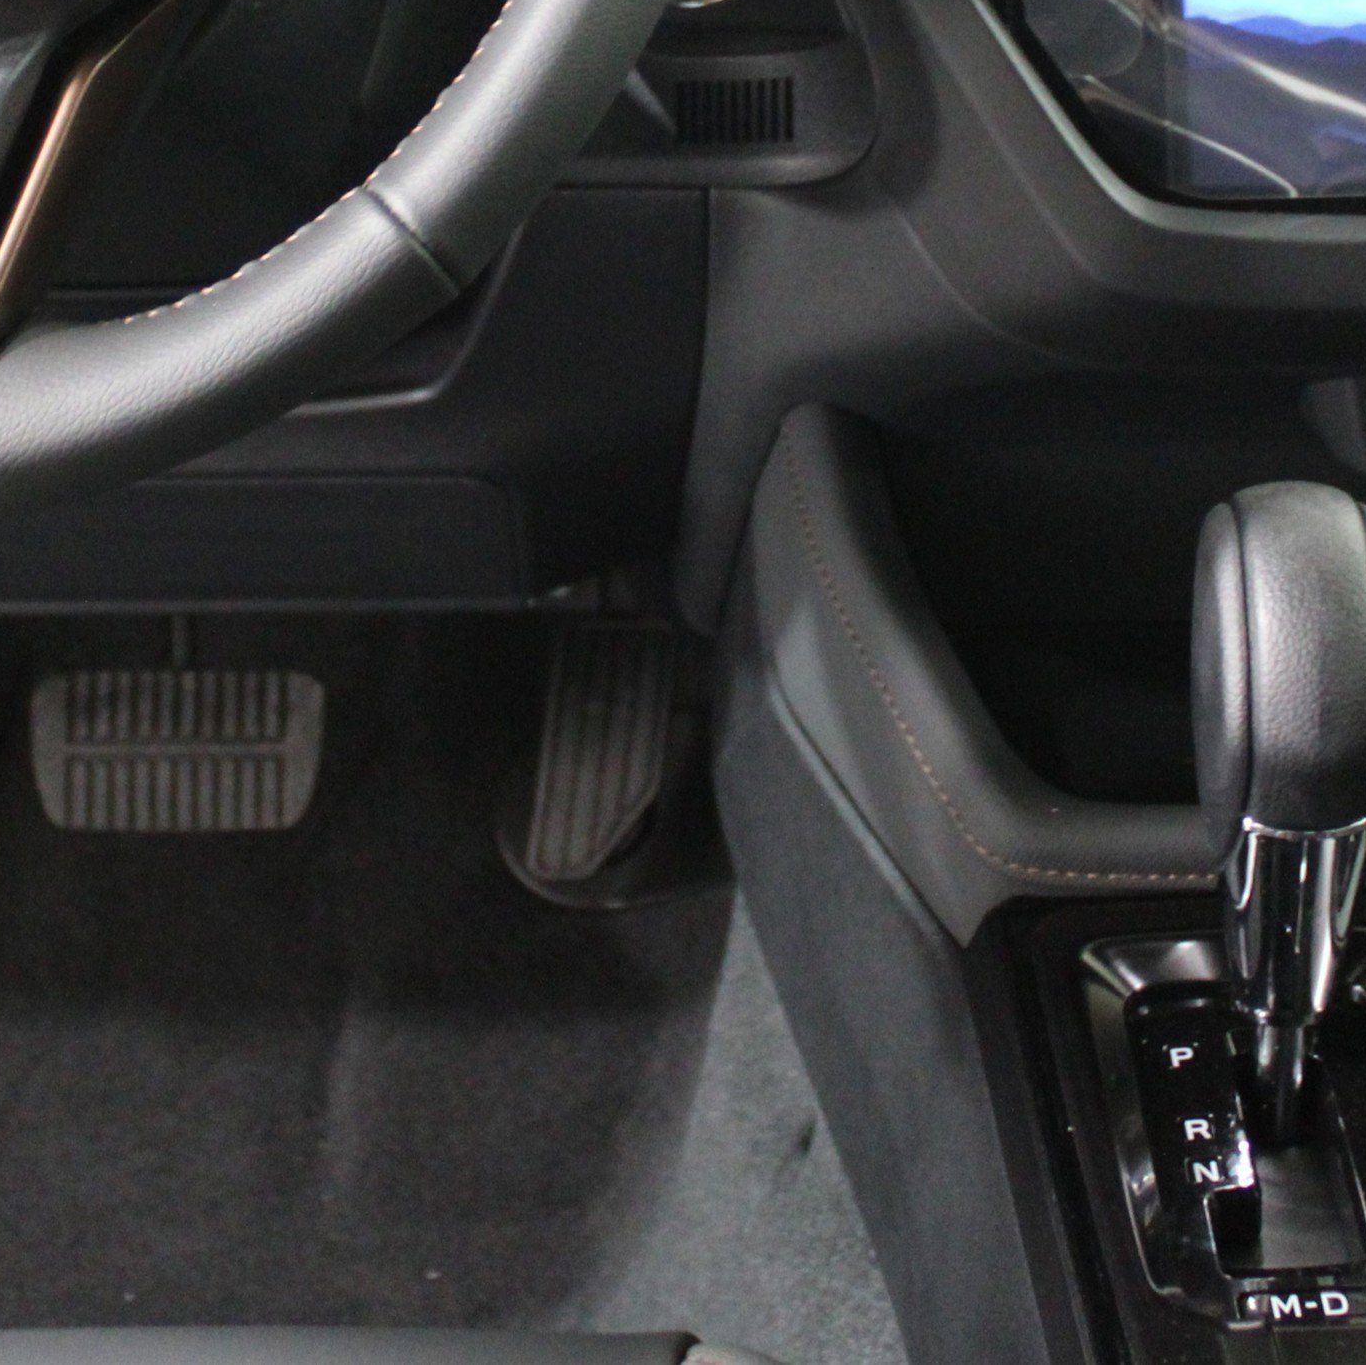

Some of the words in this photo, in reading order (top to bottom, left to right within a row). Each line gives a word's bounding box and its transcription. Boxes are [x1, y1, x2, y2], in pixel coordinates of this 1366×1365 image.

[1168, 1046, 1194, 1067] P
[1184, 1118, 1212, 1141] R
[1192, 1161, 1220, 1183] N
